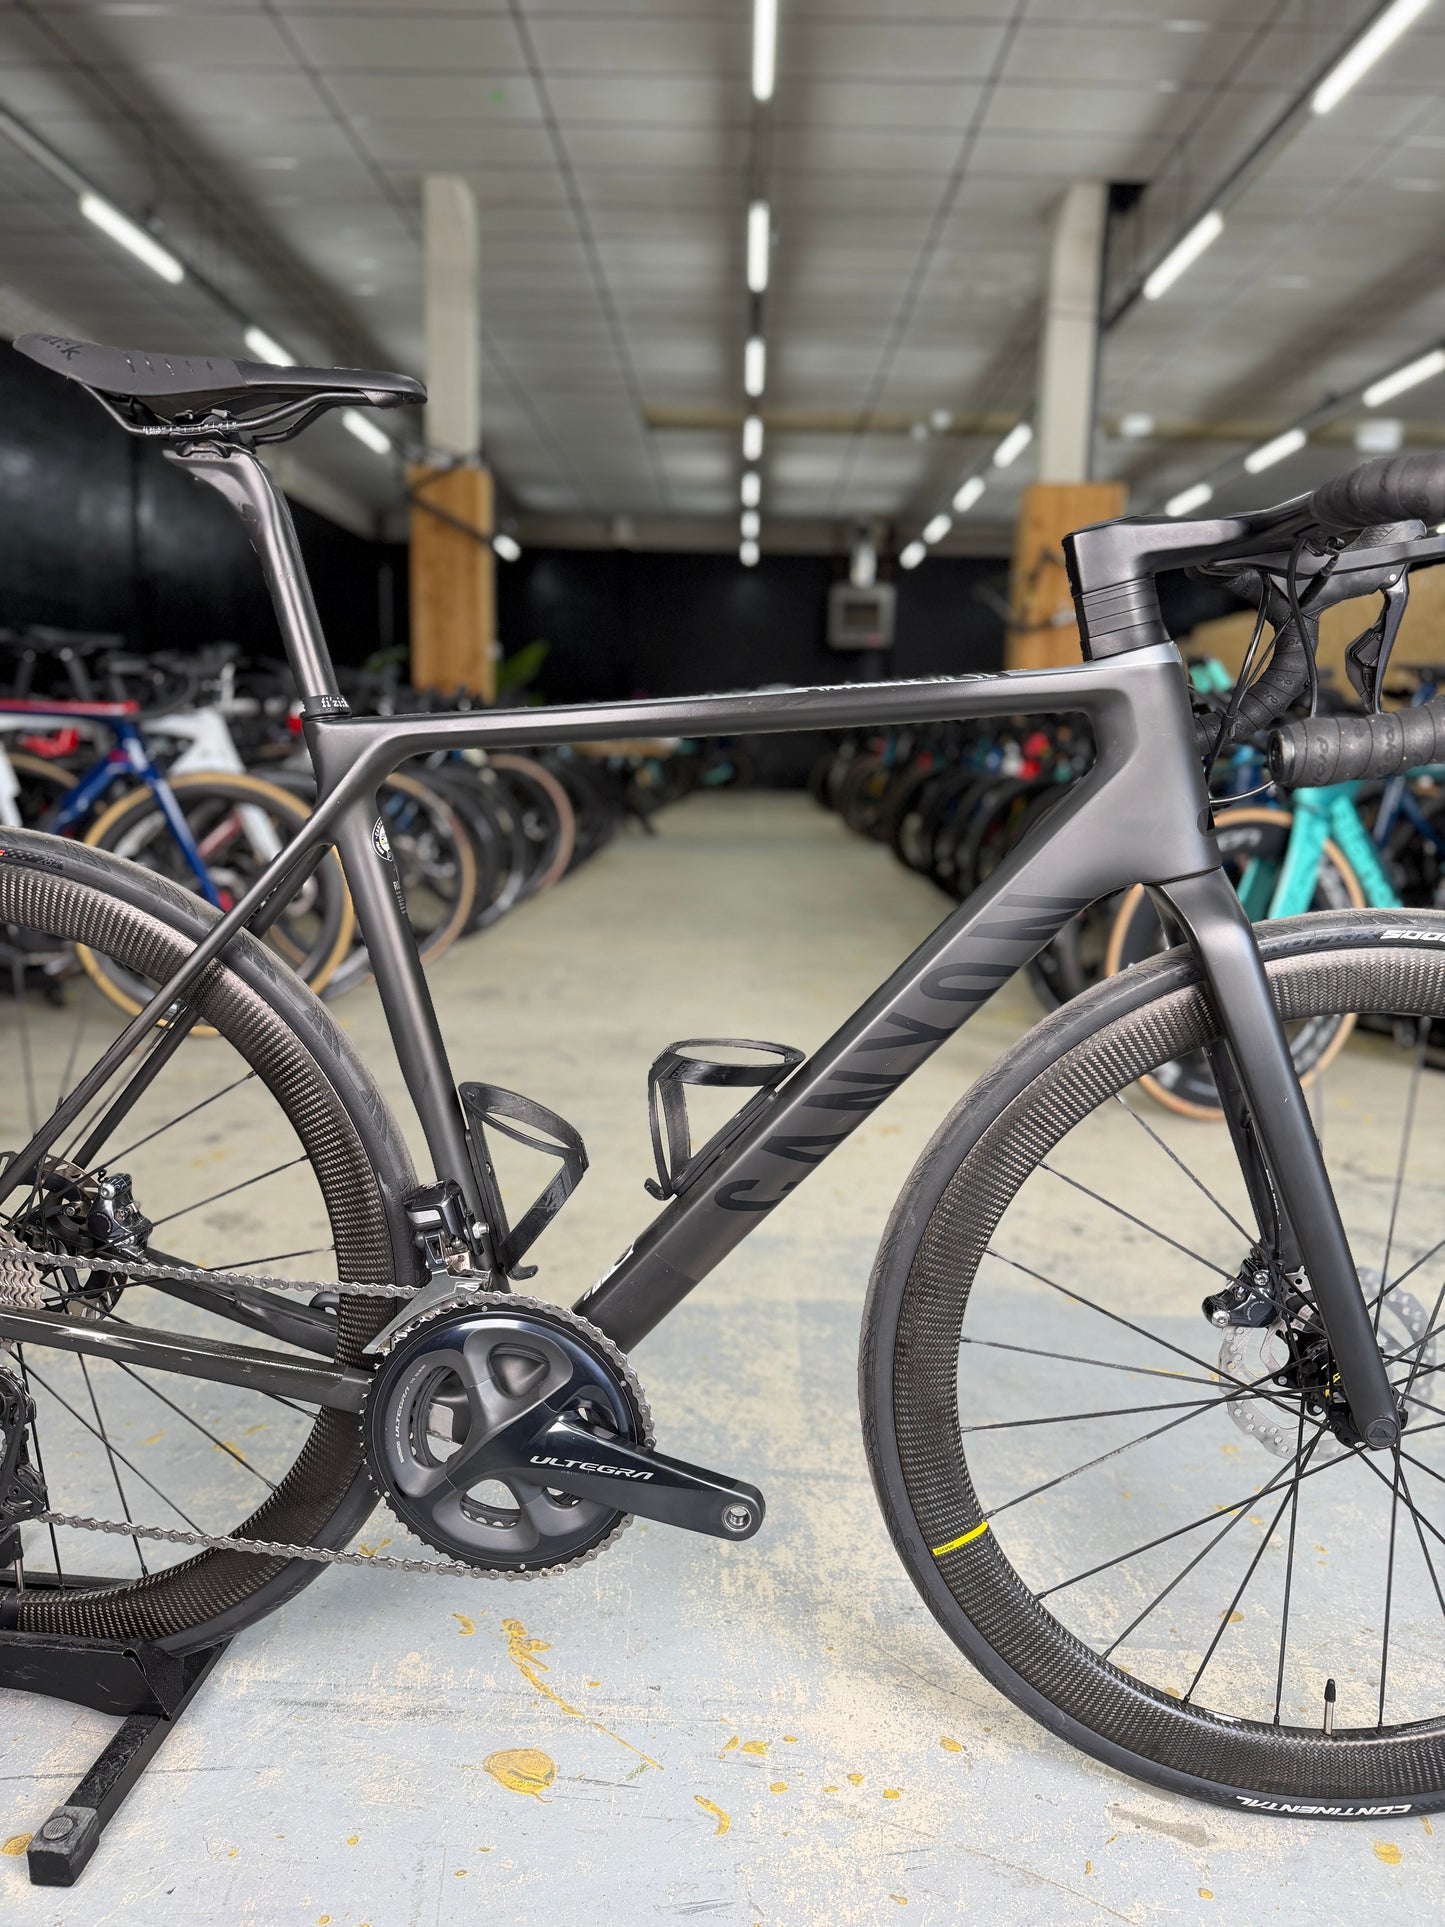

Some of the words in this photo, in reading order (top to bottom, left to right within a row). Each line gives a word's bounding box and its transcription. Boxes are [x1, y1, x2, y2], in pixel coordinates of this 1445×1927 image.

[713, 893, 1098, 1212] CANYON
[529, 1455, 655, 1480] ULTEGRA
[1236, 1795, 1412, 1816] CONTINENTAL
